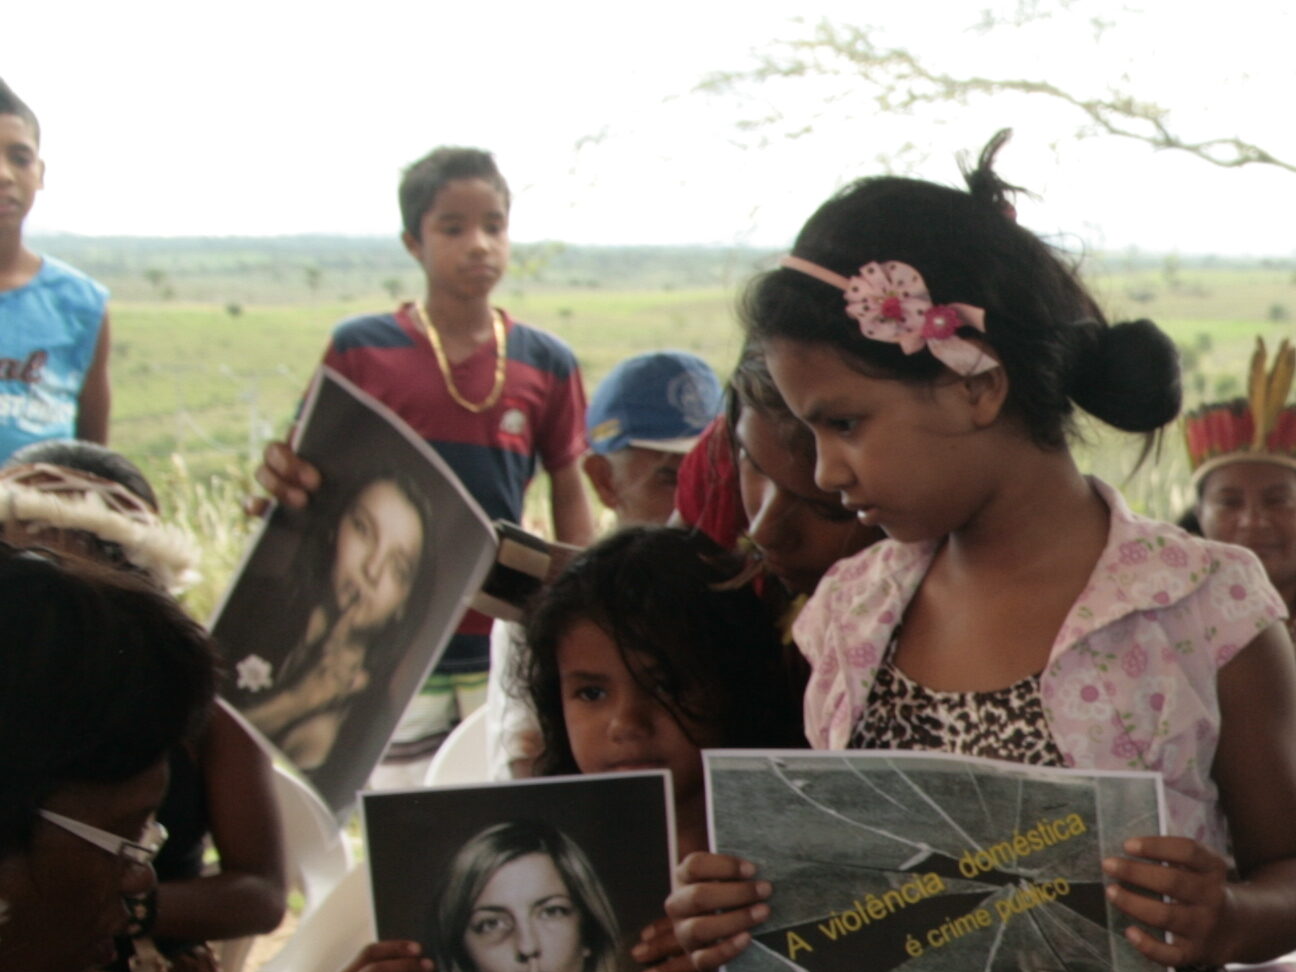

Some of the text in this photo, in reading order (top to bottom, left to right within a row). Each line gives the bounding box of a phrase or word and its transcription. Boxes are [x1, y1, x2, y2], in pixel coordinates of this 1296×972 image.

[784, 810, 1087, 961] A violência doméstica
[905, 933, 924, 958] é
[927, 910, 993, 951] crime
